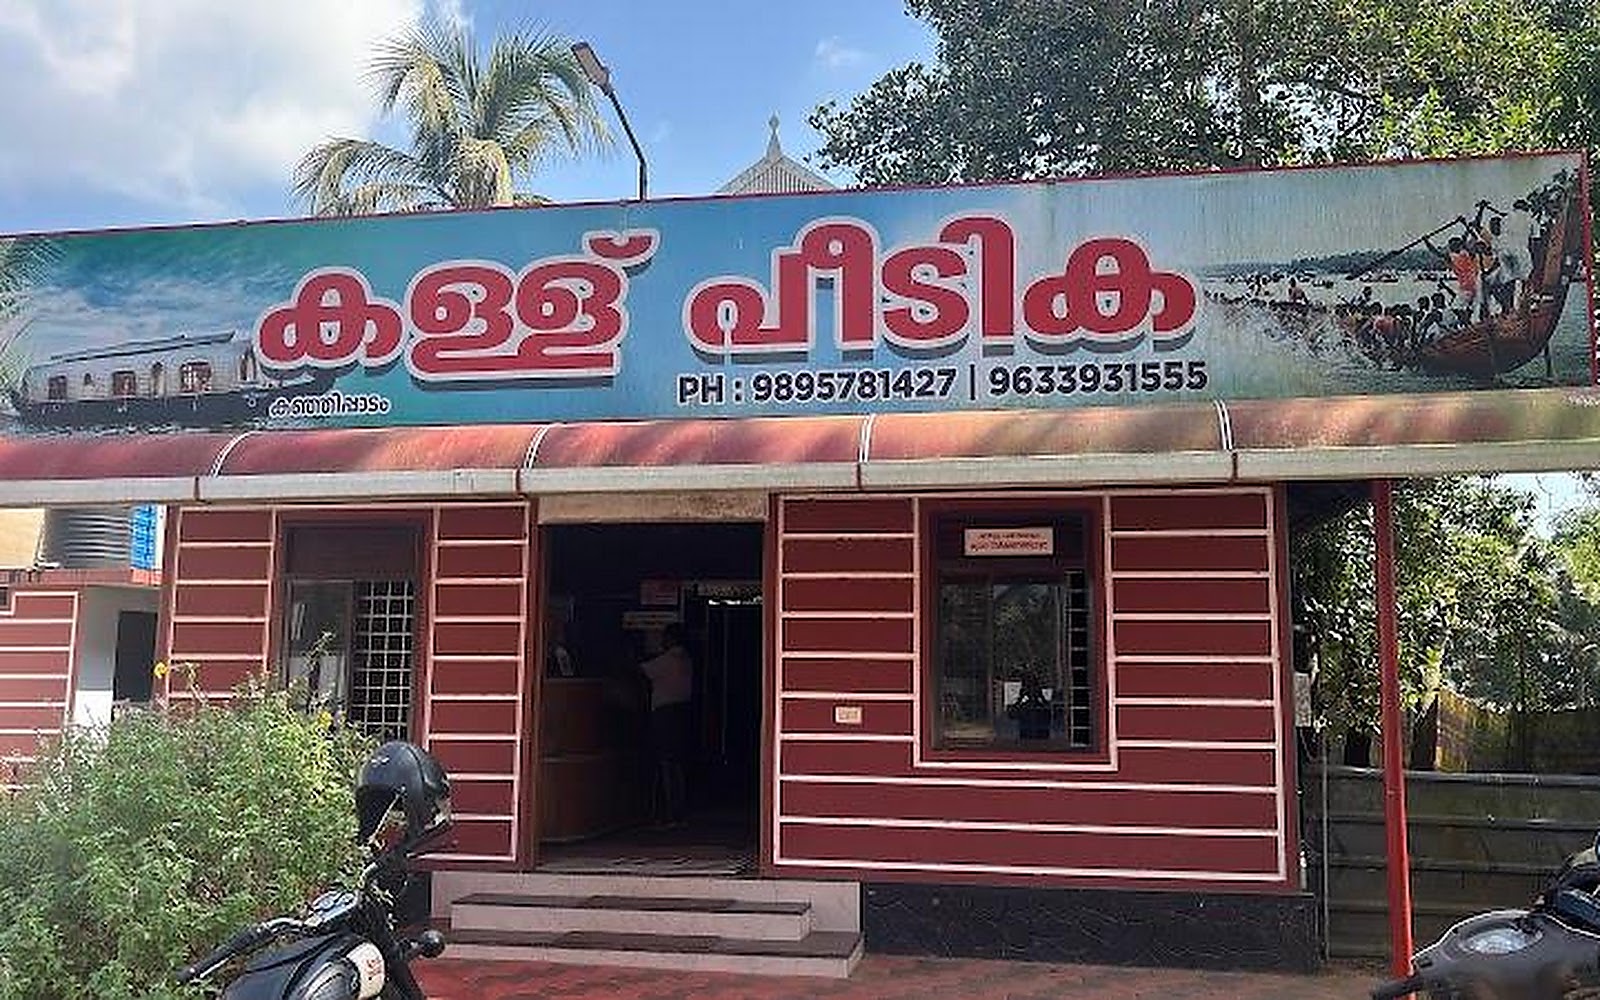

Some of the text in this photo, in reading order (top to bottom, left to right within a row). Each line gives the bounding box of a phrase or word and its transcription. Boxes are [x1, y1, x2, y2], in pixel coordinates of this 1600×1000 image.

[256, 213, 1199, 377] കള്ള് പീടിക
[678, 376, 723, 402] PH
[752, 369, 957, 401] 9895781427
[989, 361, 1208, 396] 9633931555
